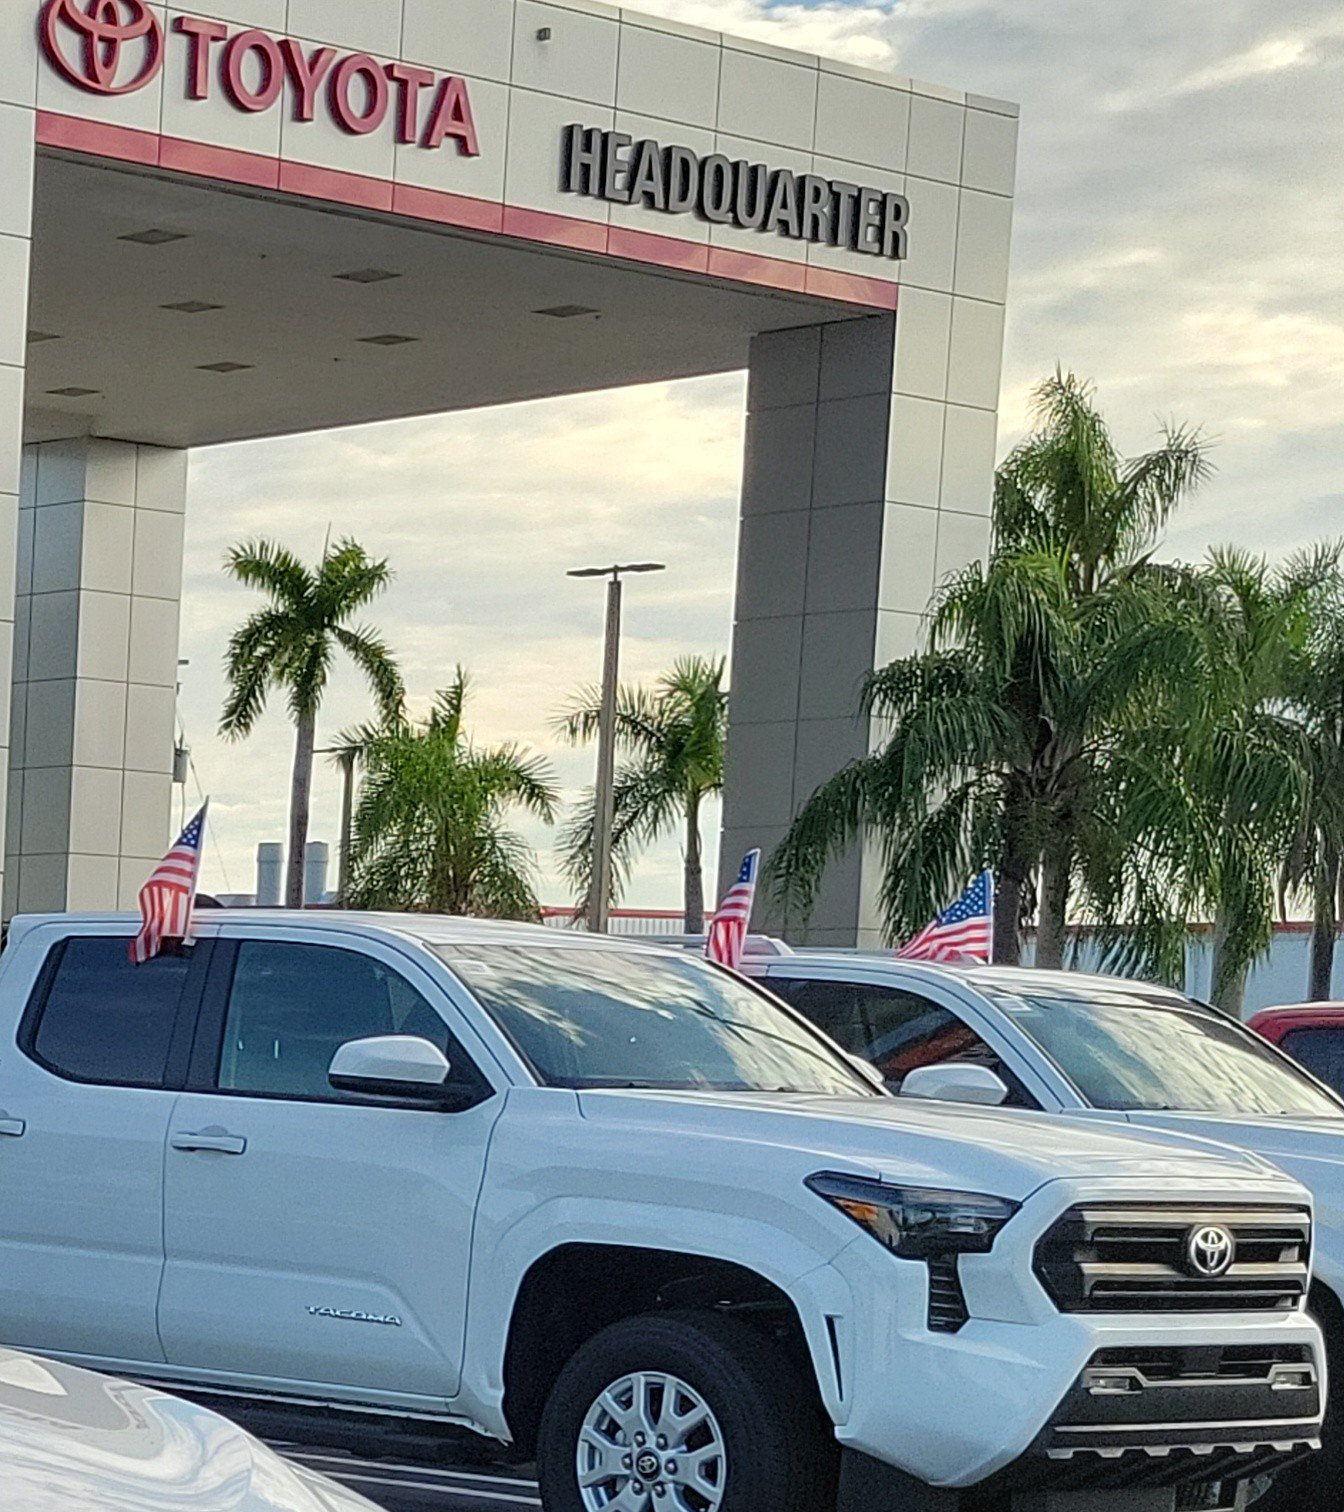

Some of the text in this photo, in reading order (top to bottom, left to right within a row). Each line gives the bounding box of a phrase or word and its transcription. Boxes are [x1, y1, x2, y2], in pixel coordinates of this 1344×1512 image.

[174, 15, 481, 157] TOYOTA
[560, 123, 910, 260] HEADQUARTER
[303, 1305, 403, 1326] TACOMA
